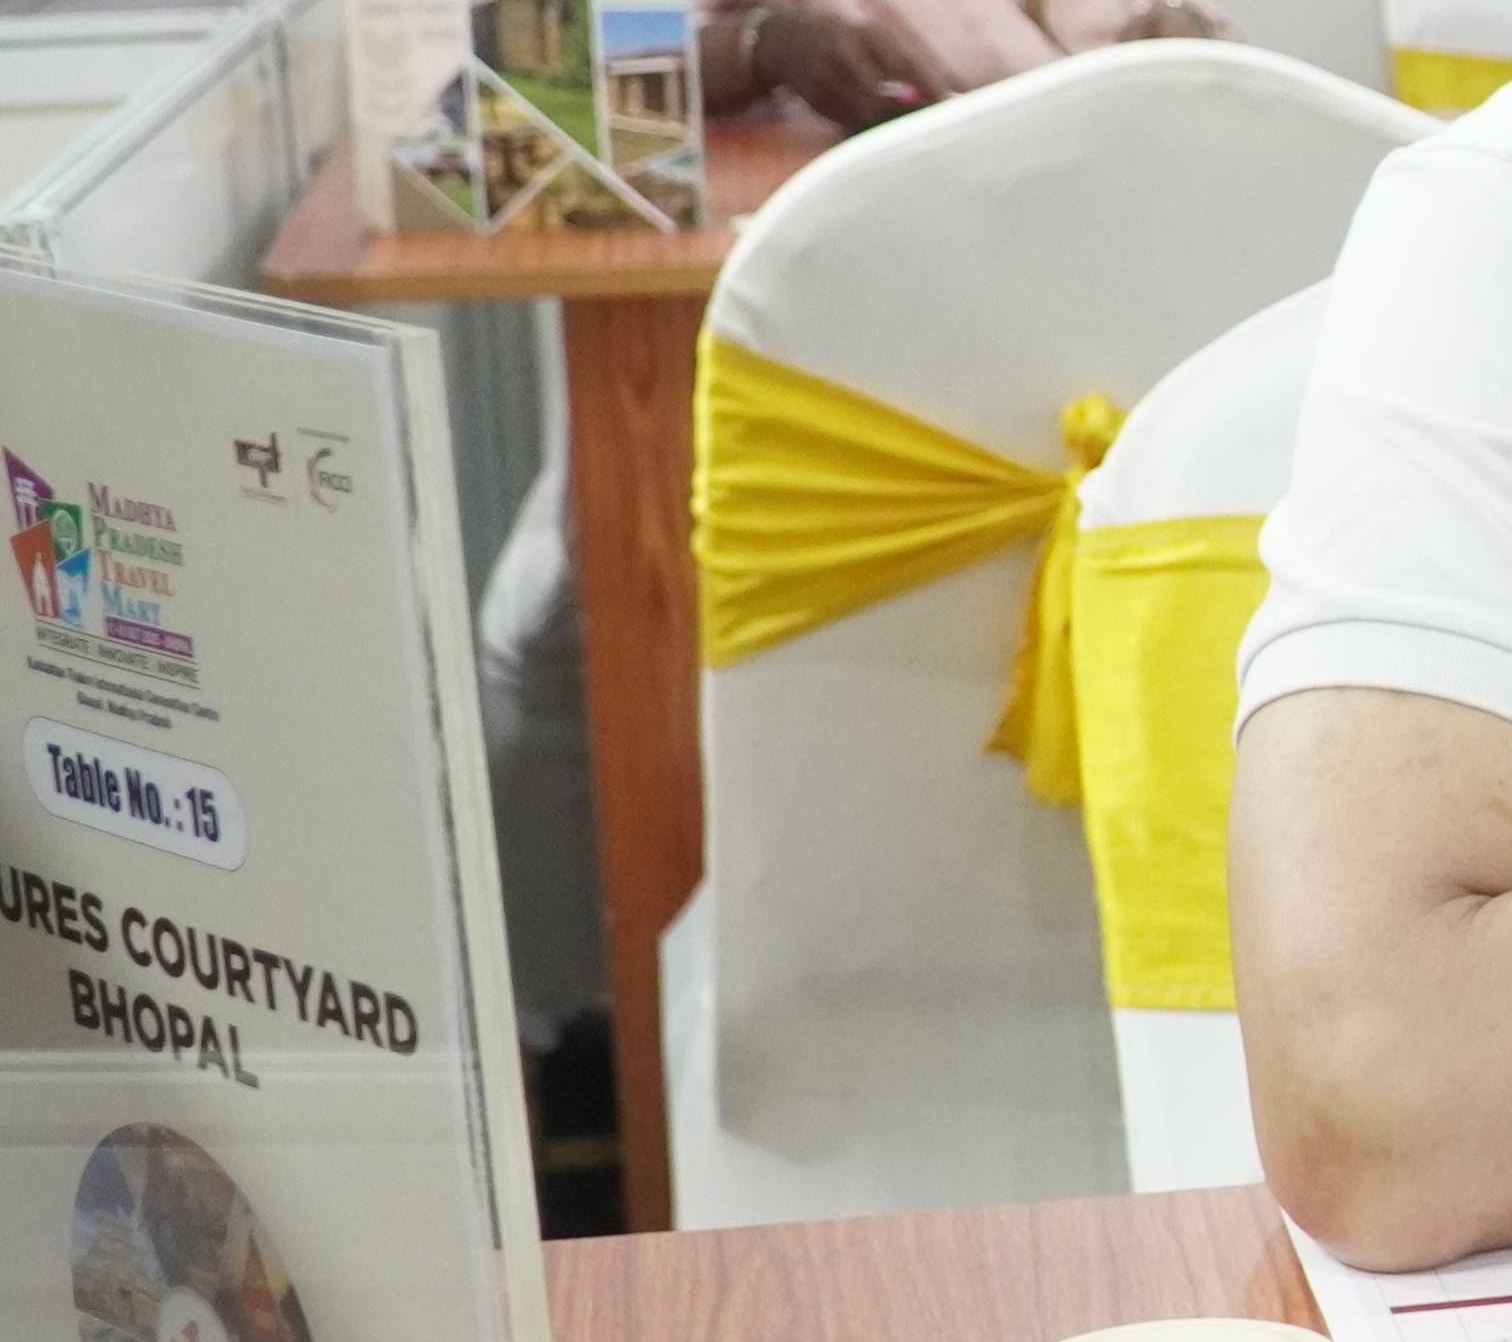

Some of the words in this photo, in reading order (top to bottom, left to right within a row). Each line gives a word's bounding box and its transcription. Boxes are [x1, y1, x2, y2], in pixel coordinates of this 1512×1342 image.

[47, 743, 121, 813] Table
[186, 786, 220, 843] 15
[69, 967, 259, 1089] BHOPAL
[122, 907, 418, 1057] COURTYARD
